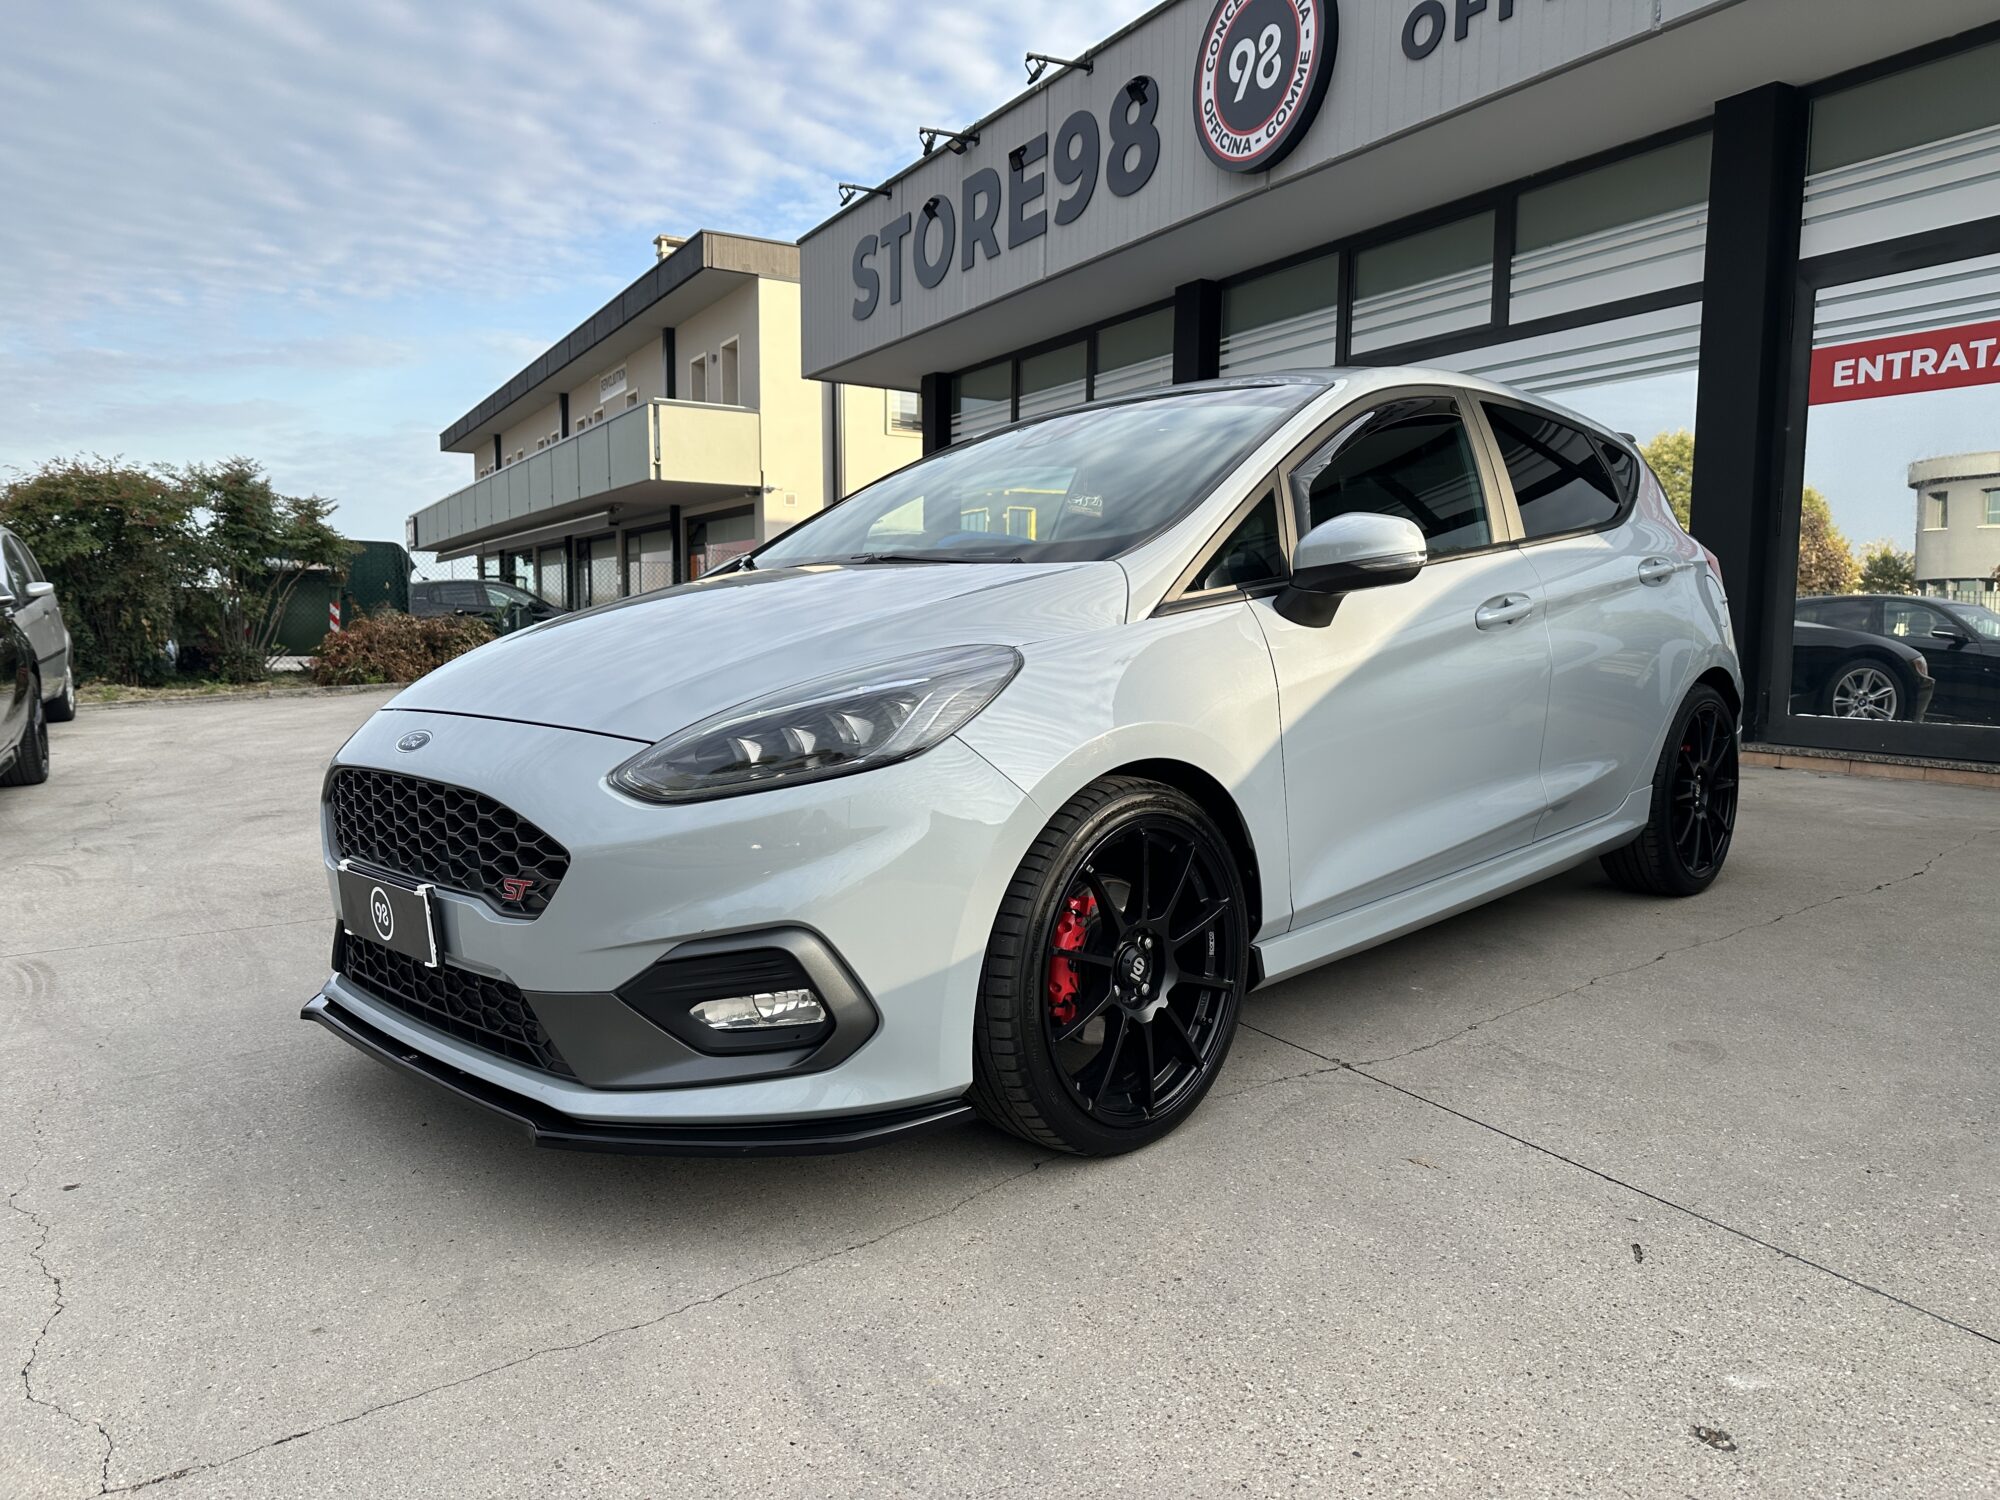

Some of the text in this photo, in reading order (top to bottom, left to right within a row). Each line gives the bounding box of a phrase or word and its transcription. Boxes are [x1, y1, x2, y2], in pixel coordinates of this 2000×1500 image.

[1229, 23, 1282, 104] 98
[1204, 50, 1311, 154] OFFICINA GOMME
[851, 75, 1160, 321] STORE98
[1833, 338, 2000, 388] ENTRAT
[375, 901, 389, 926] 98
[502, 877, 534, 900] ST
